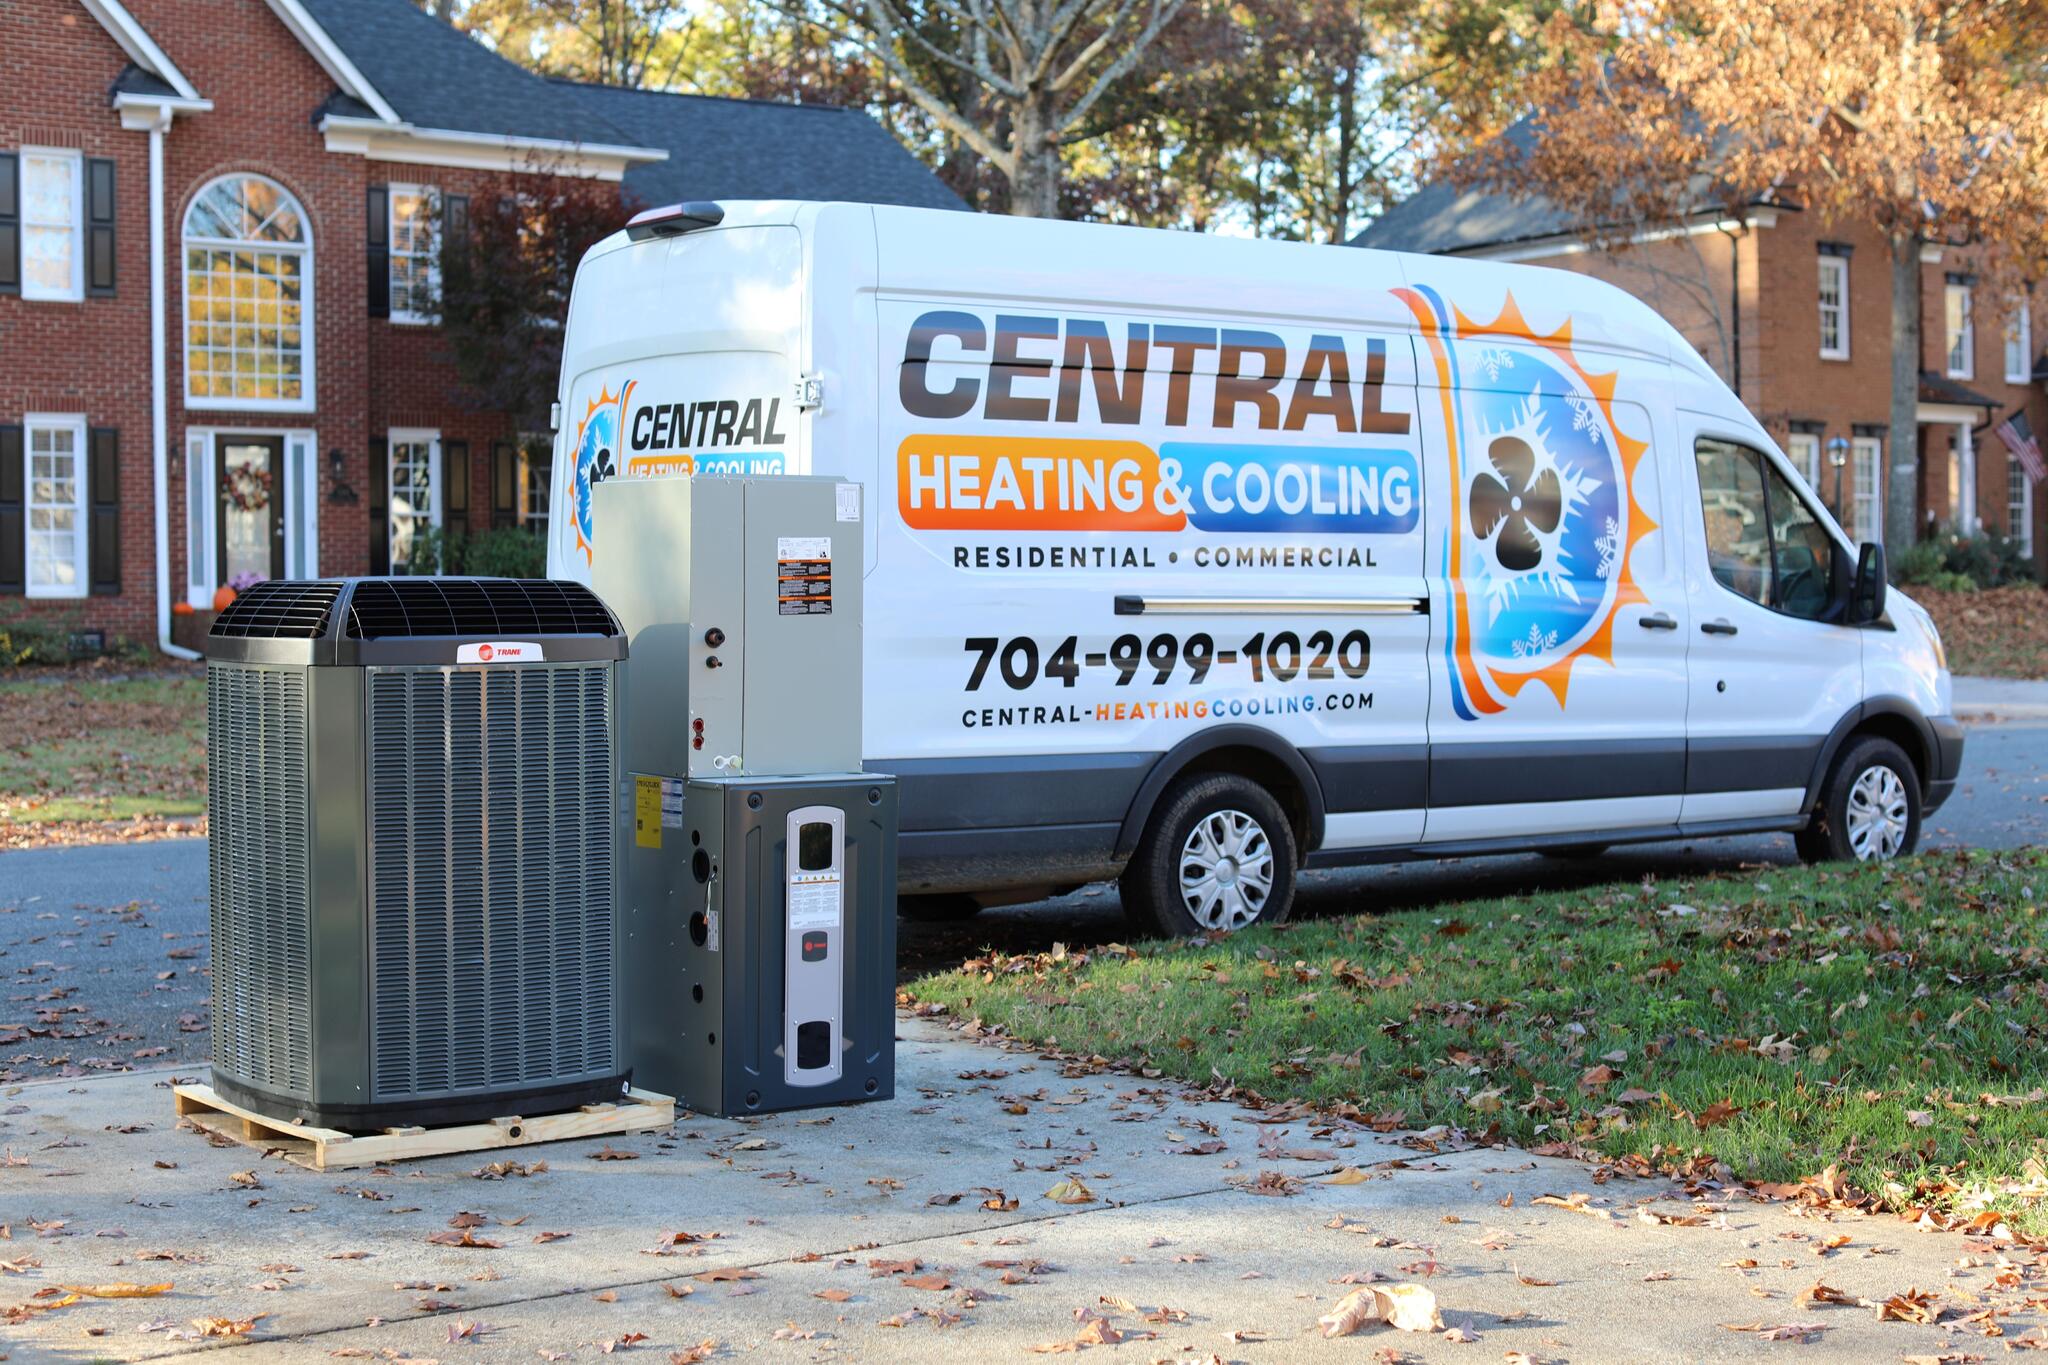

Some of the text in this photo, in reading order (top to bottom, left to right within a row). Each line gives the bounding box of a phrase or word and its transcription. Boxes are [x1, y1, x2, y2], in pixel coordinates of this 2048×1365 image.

[899, 310, 1412, 435] CENTRAL
[631, 398, 786, 451] CENTRAL
[909, 454, 1412, 517] HEATING & COOLING
[954, 546, 1378, 568] RESIDENTIAL COMMERCIAL
[964, 629, 1371, 692] 704-999-1020
[962, 693, 1374, 728] CENTRAL-HEATINGCOOLING.COM
